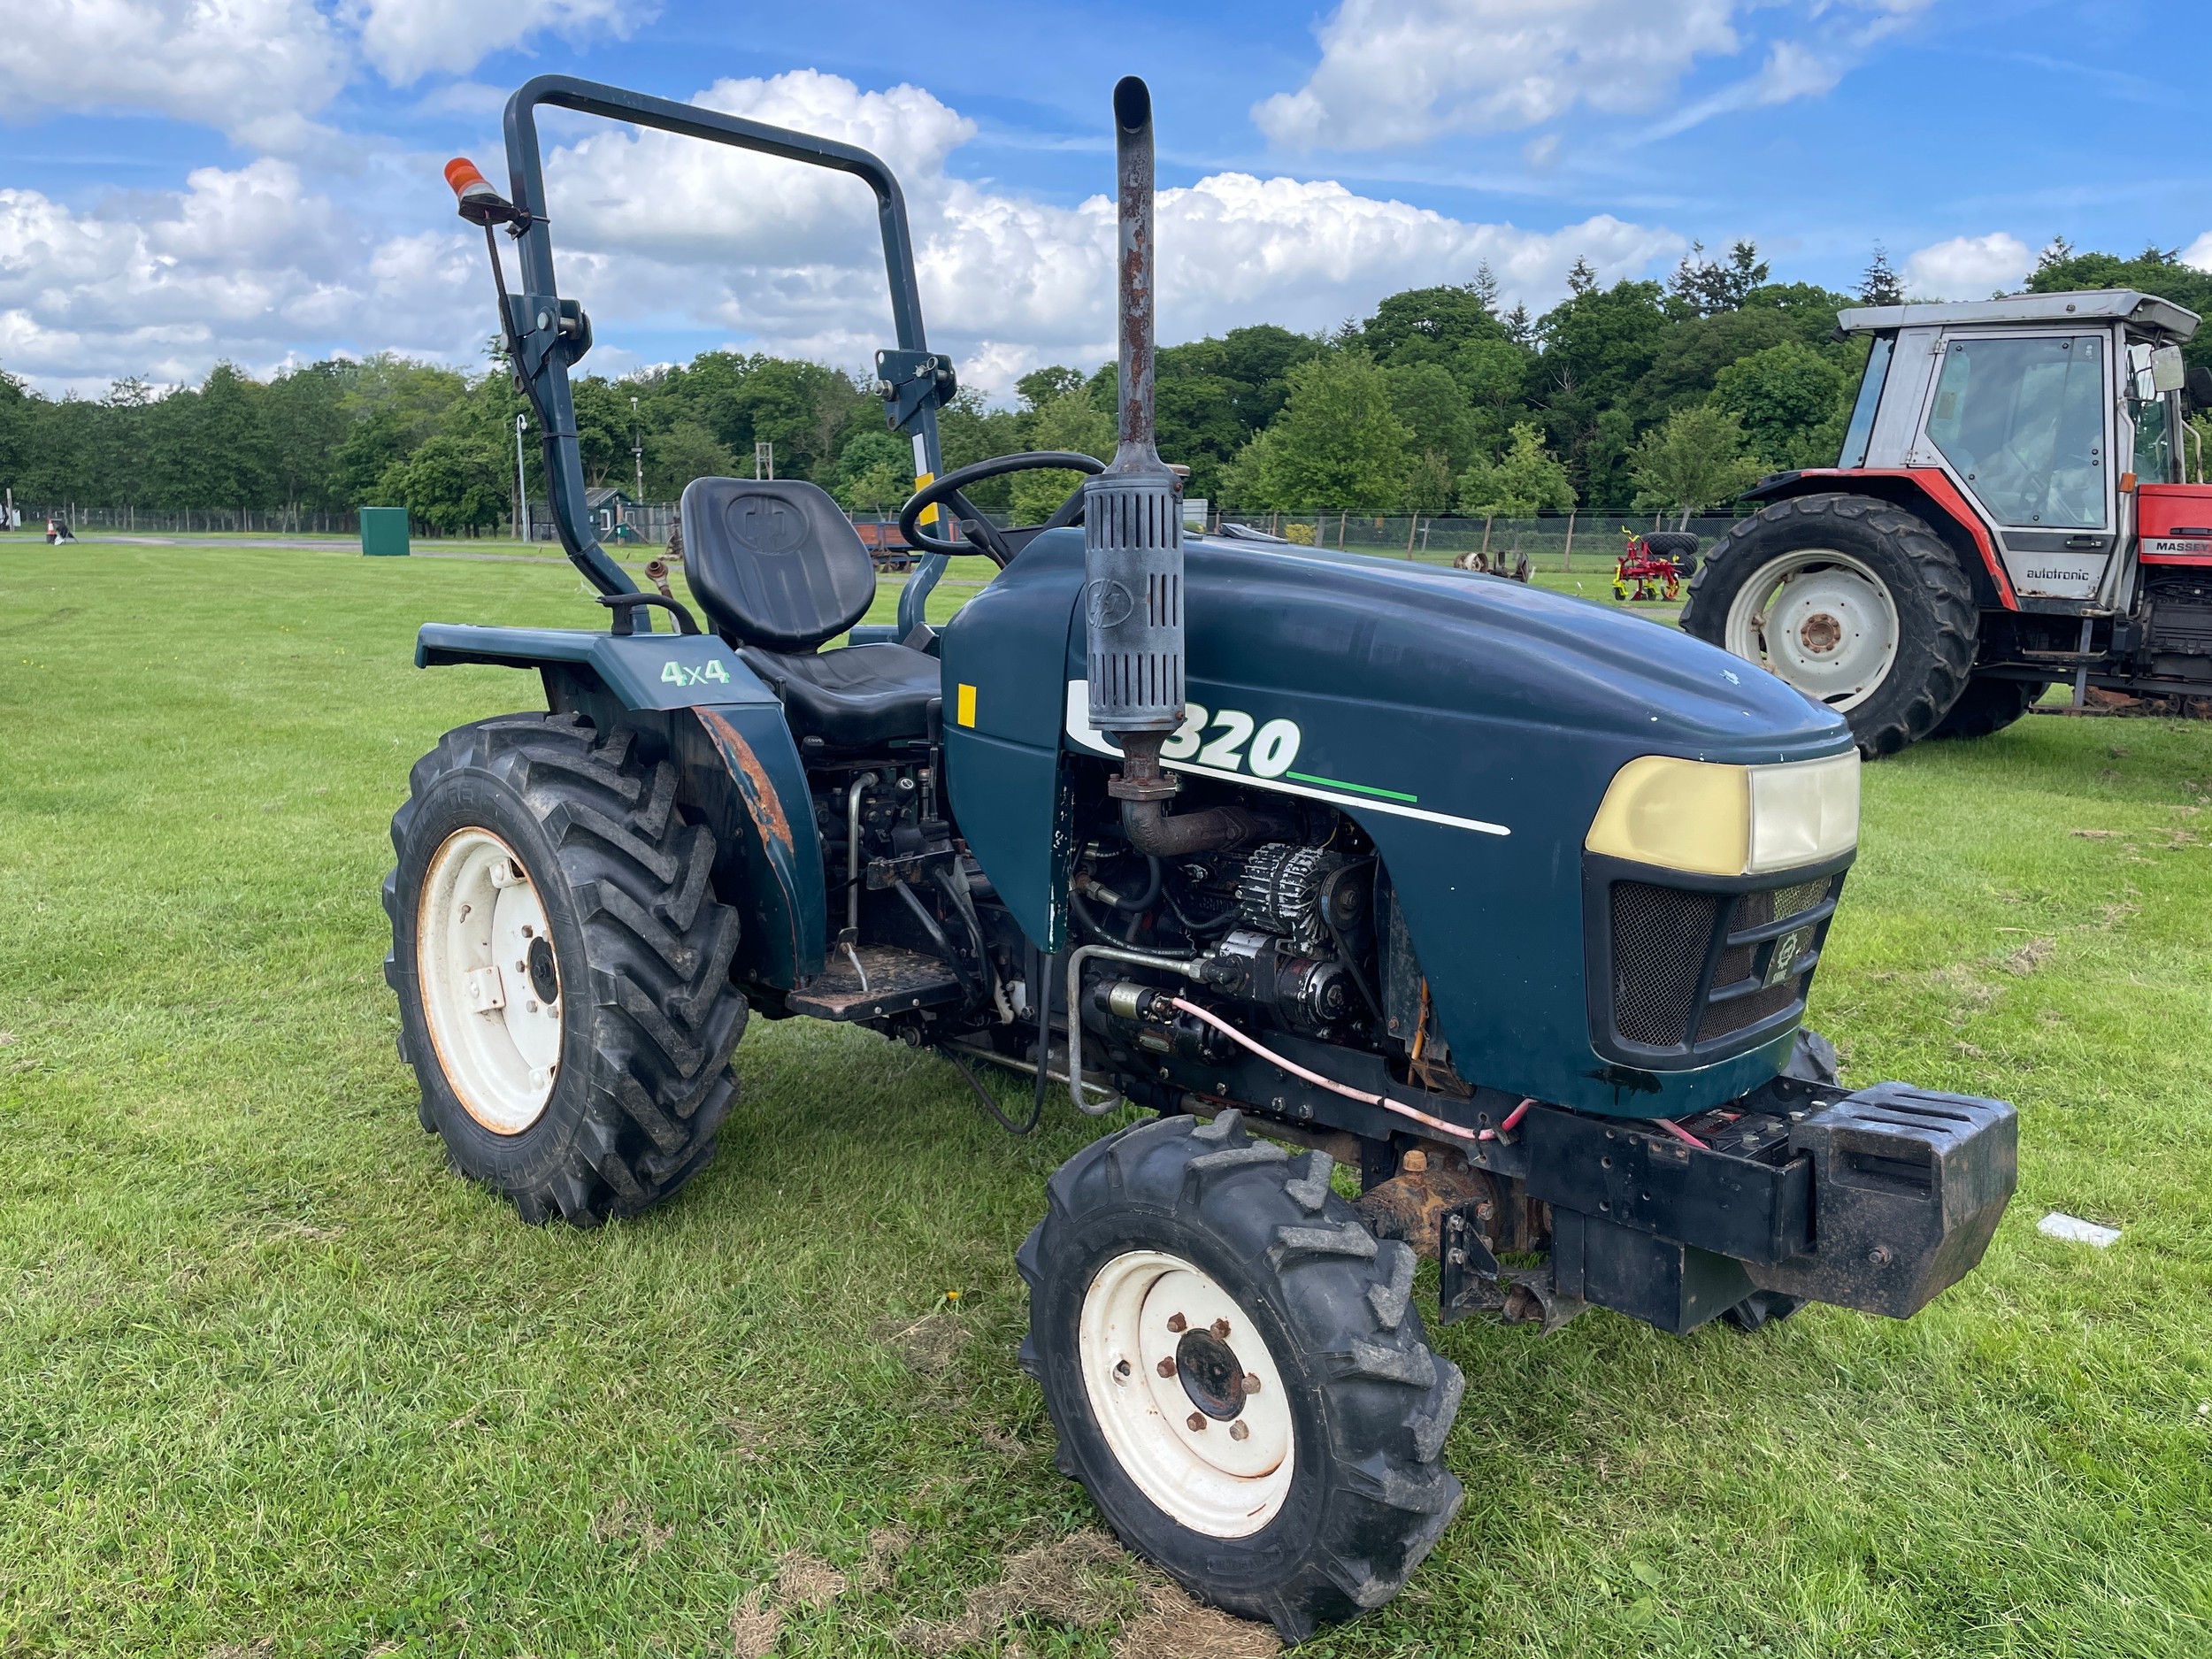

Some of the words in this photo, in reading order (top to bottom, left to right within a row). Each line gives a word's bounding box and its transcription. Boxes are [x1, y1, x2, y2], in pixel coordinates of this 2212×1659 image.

[2156, 541, 2209, 552] MASSEY
[2026, 567, 2090, 581] autotronic
[660, 659, 730, 687] 4x4
[1159, 701, 1302, 779] 320
